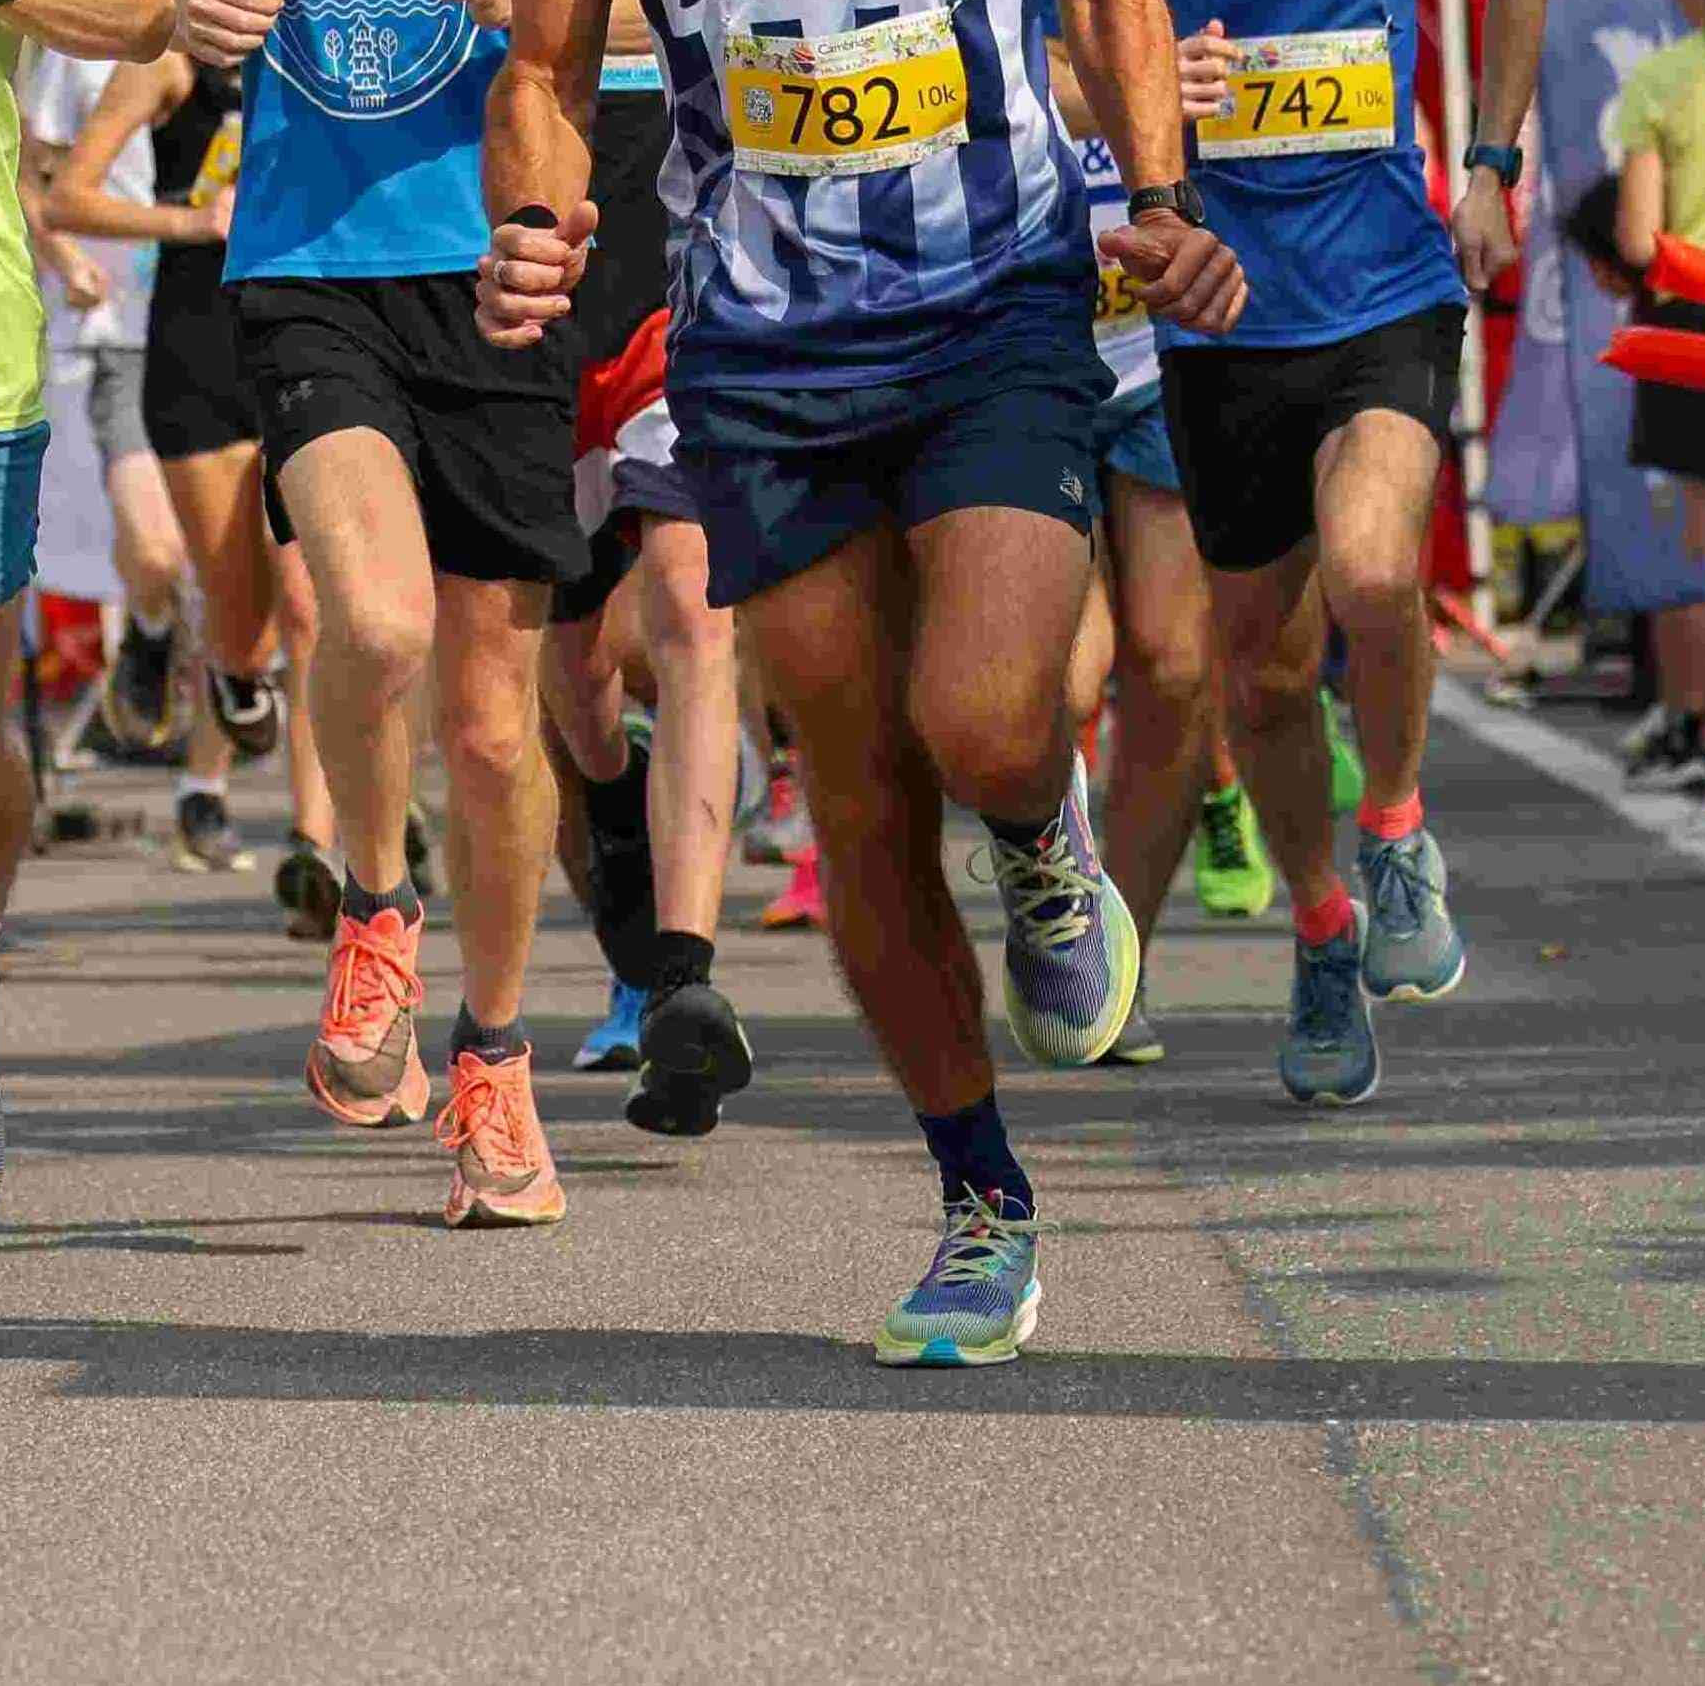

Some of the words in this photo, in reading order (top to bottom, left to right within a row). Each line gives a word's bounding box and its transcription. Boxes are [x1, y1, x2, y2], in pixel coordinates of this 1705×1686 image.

[816, 34, 876, 57] Cambridge
[780, 76, 911, 146] 782
[916, 82, 958, 110] 10k
[1243, 76, 1350, 132] 742
[1355, 89, 1388, 109] 10k
